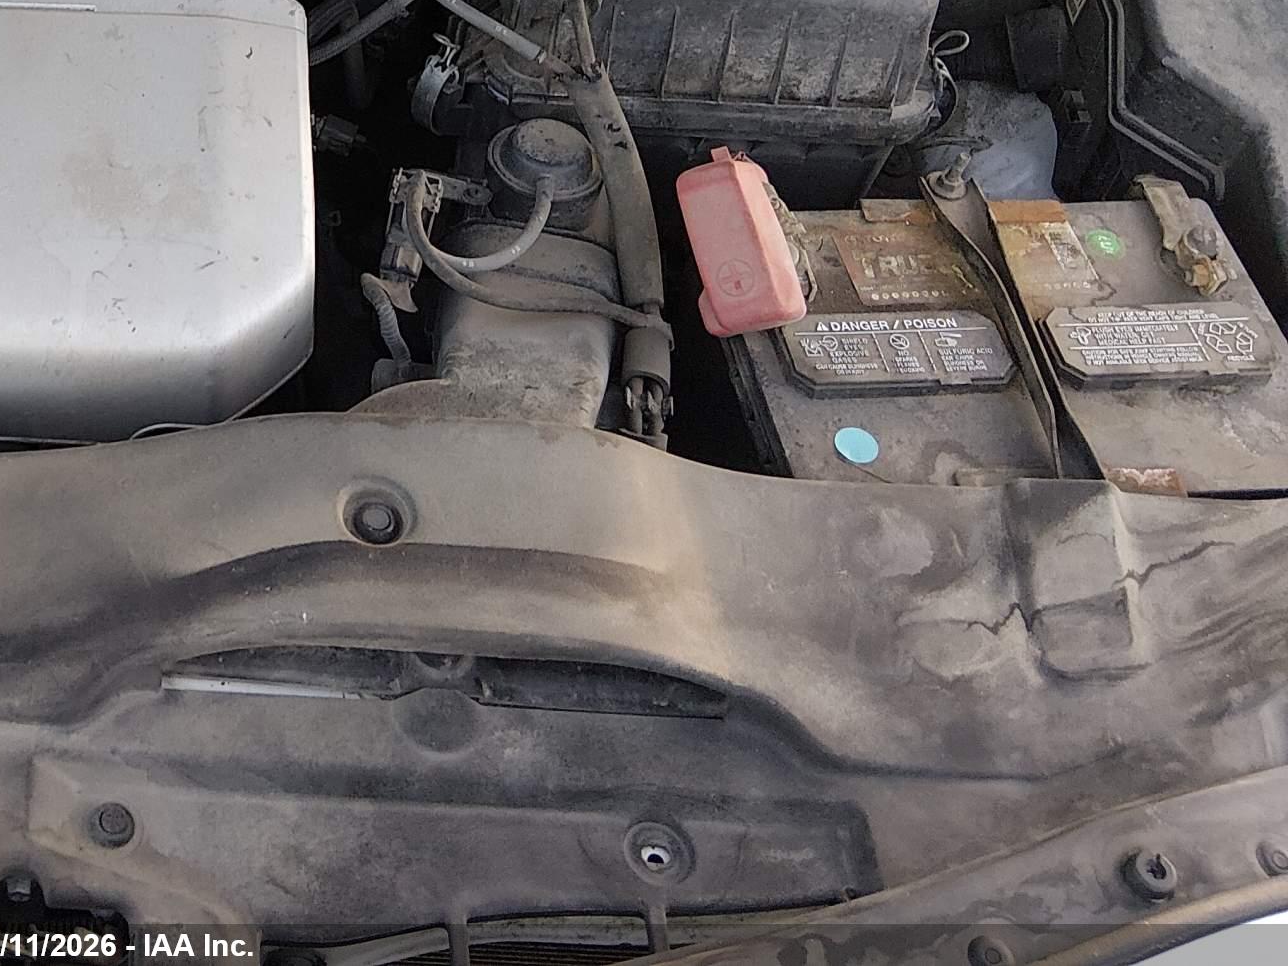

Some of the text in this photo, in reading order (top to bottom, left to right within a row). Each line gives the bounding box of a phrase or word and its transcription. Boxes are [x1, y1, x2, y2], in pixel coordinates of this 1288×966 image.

[830, 317, 958, 331] DANGER / POISON
